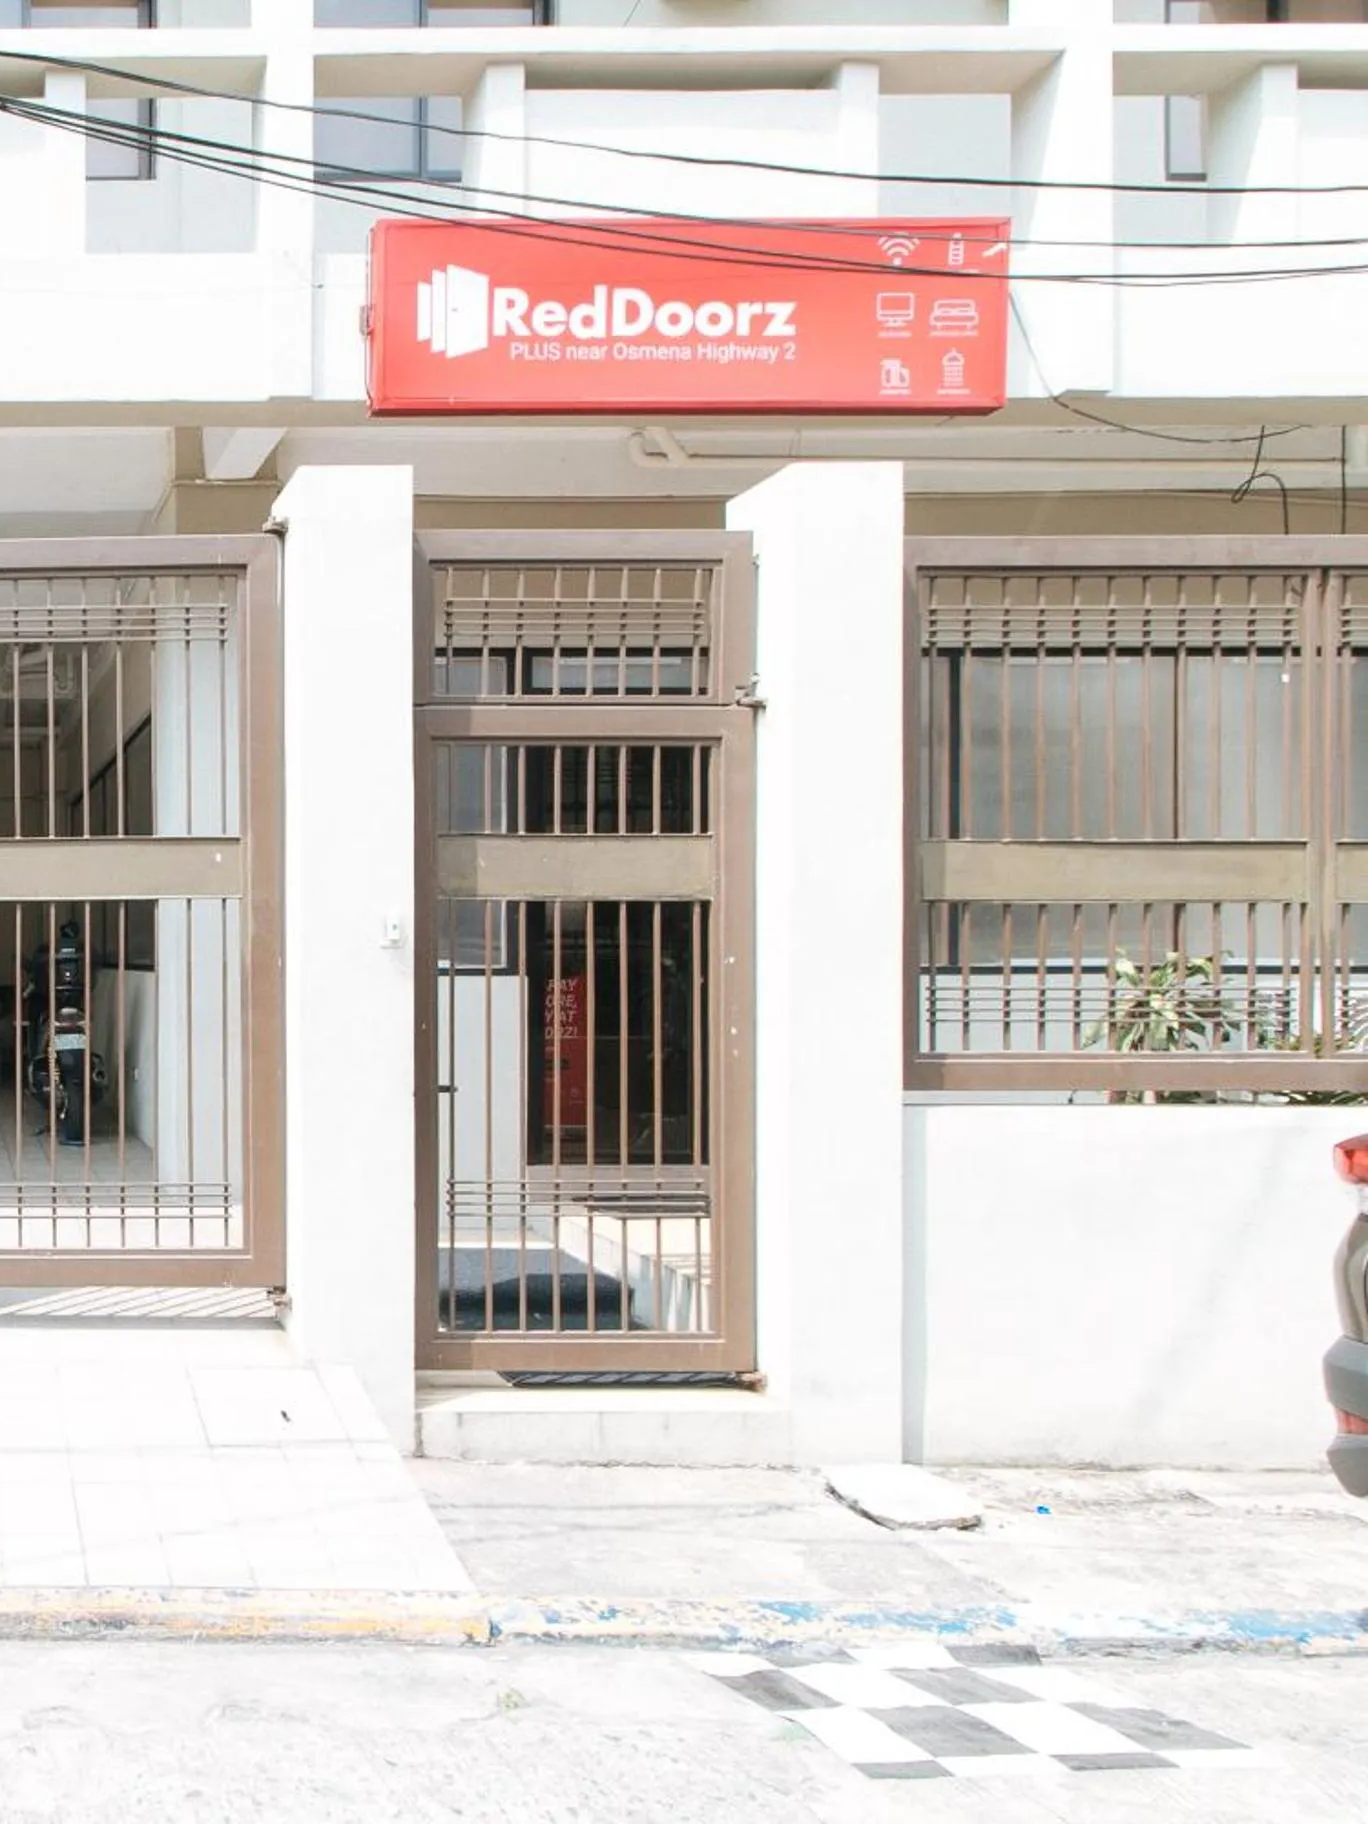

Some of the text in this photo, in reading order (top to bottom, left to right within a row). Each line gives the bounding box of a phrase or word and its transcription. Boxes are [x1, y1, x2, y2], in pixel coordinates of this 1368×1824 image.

[492, 284, 797, 339] RedDoorz
[510, 341, 797, 365] PLUS near Osmena Highway 2
